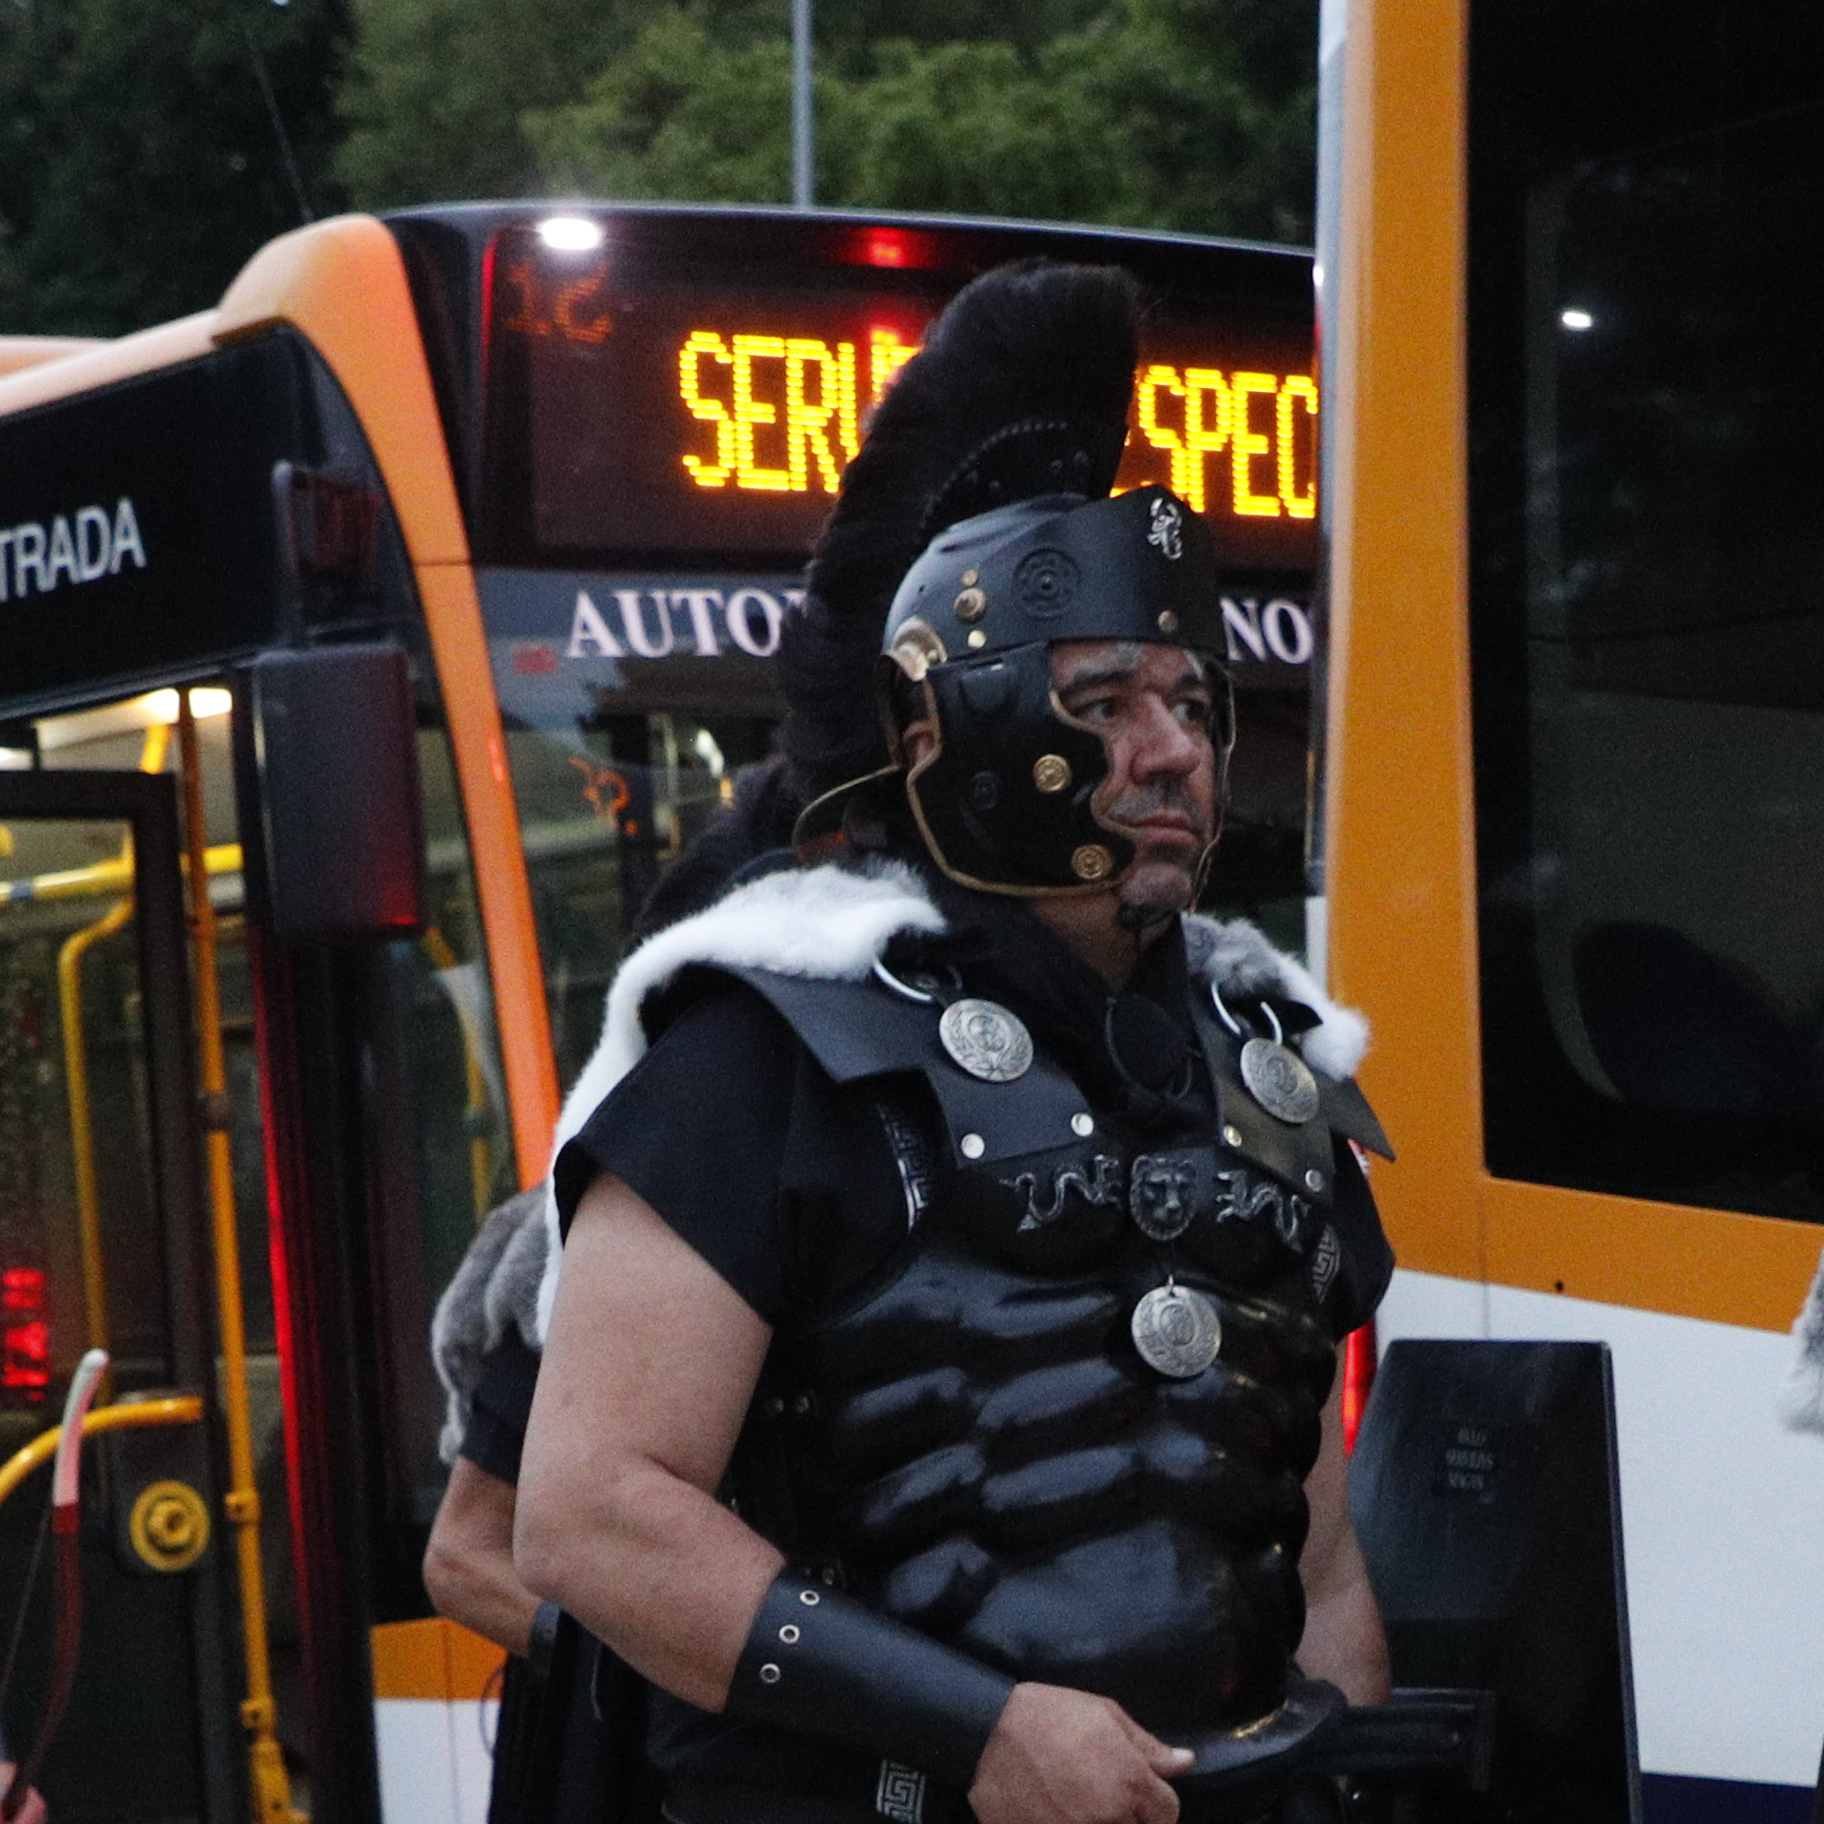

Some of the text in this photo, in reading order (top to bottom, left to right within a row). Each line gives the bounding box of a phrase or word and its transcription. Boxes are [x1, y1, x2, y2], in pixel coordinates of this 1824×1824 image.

[1112, 364, 1318, 520] SPEC
[564, 587, 1314, 664] AUTO NO
